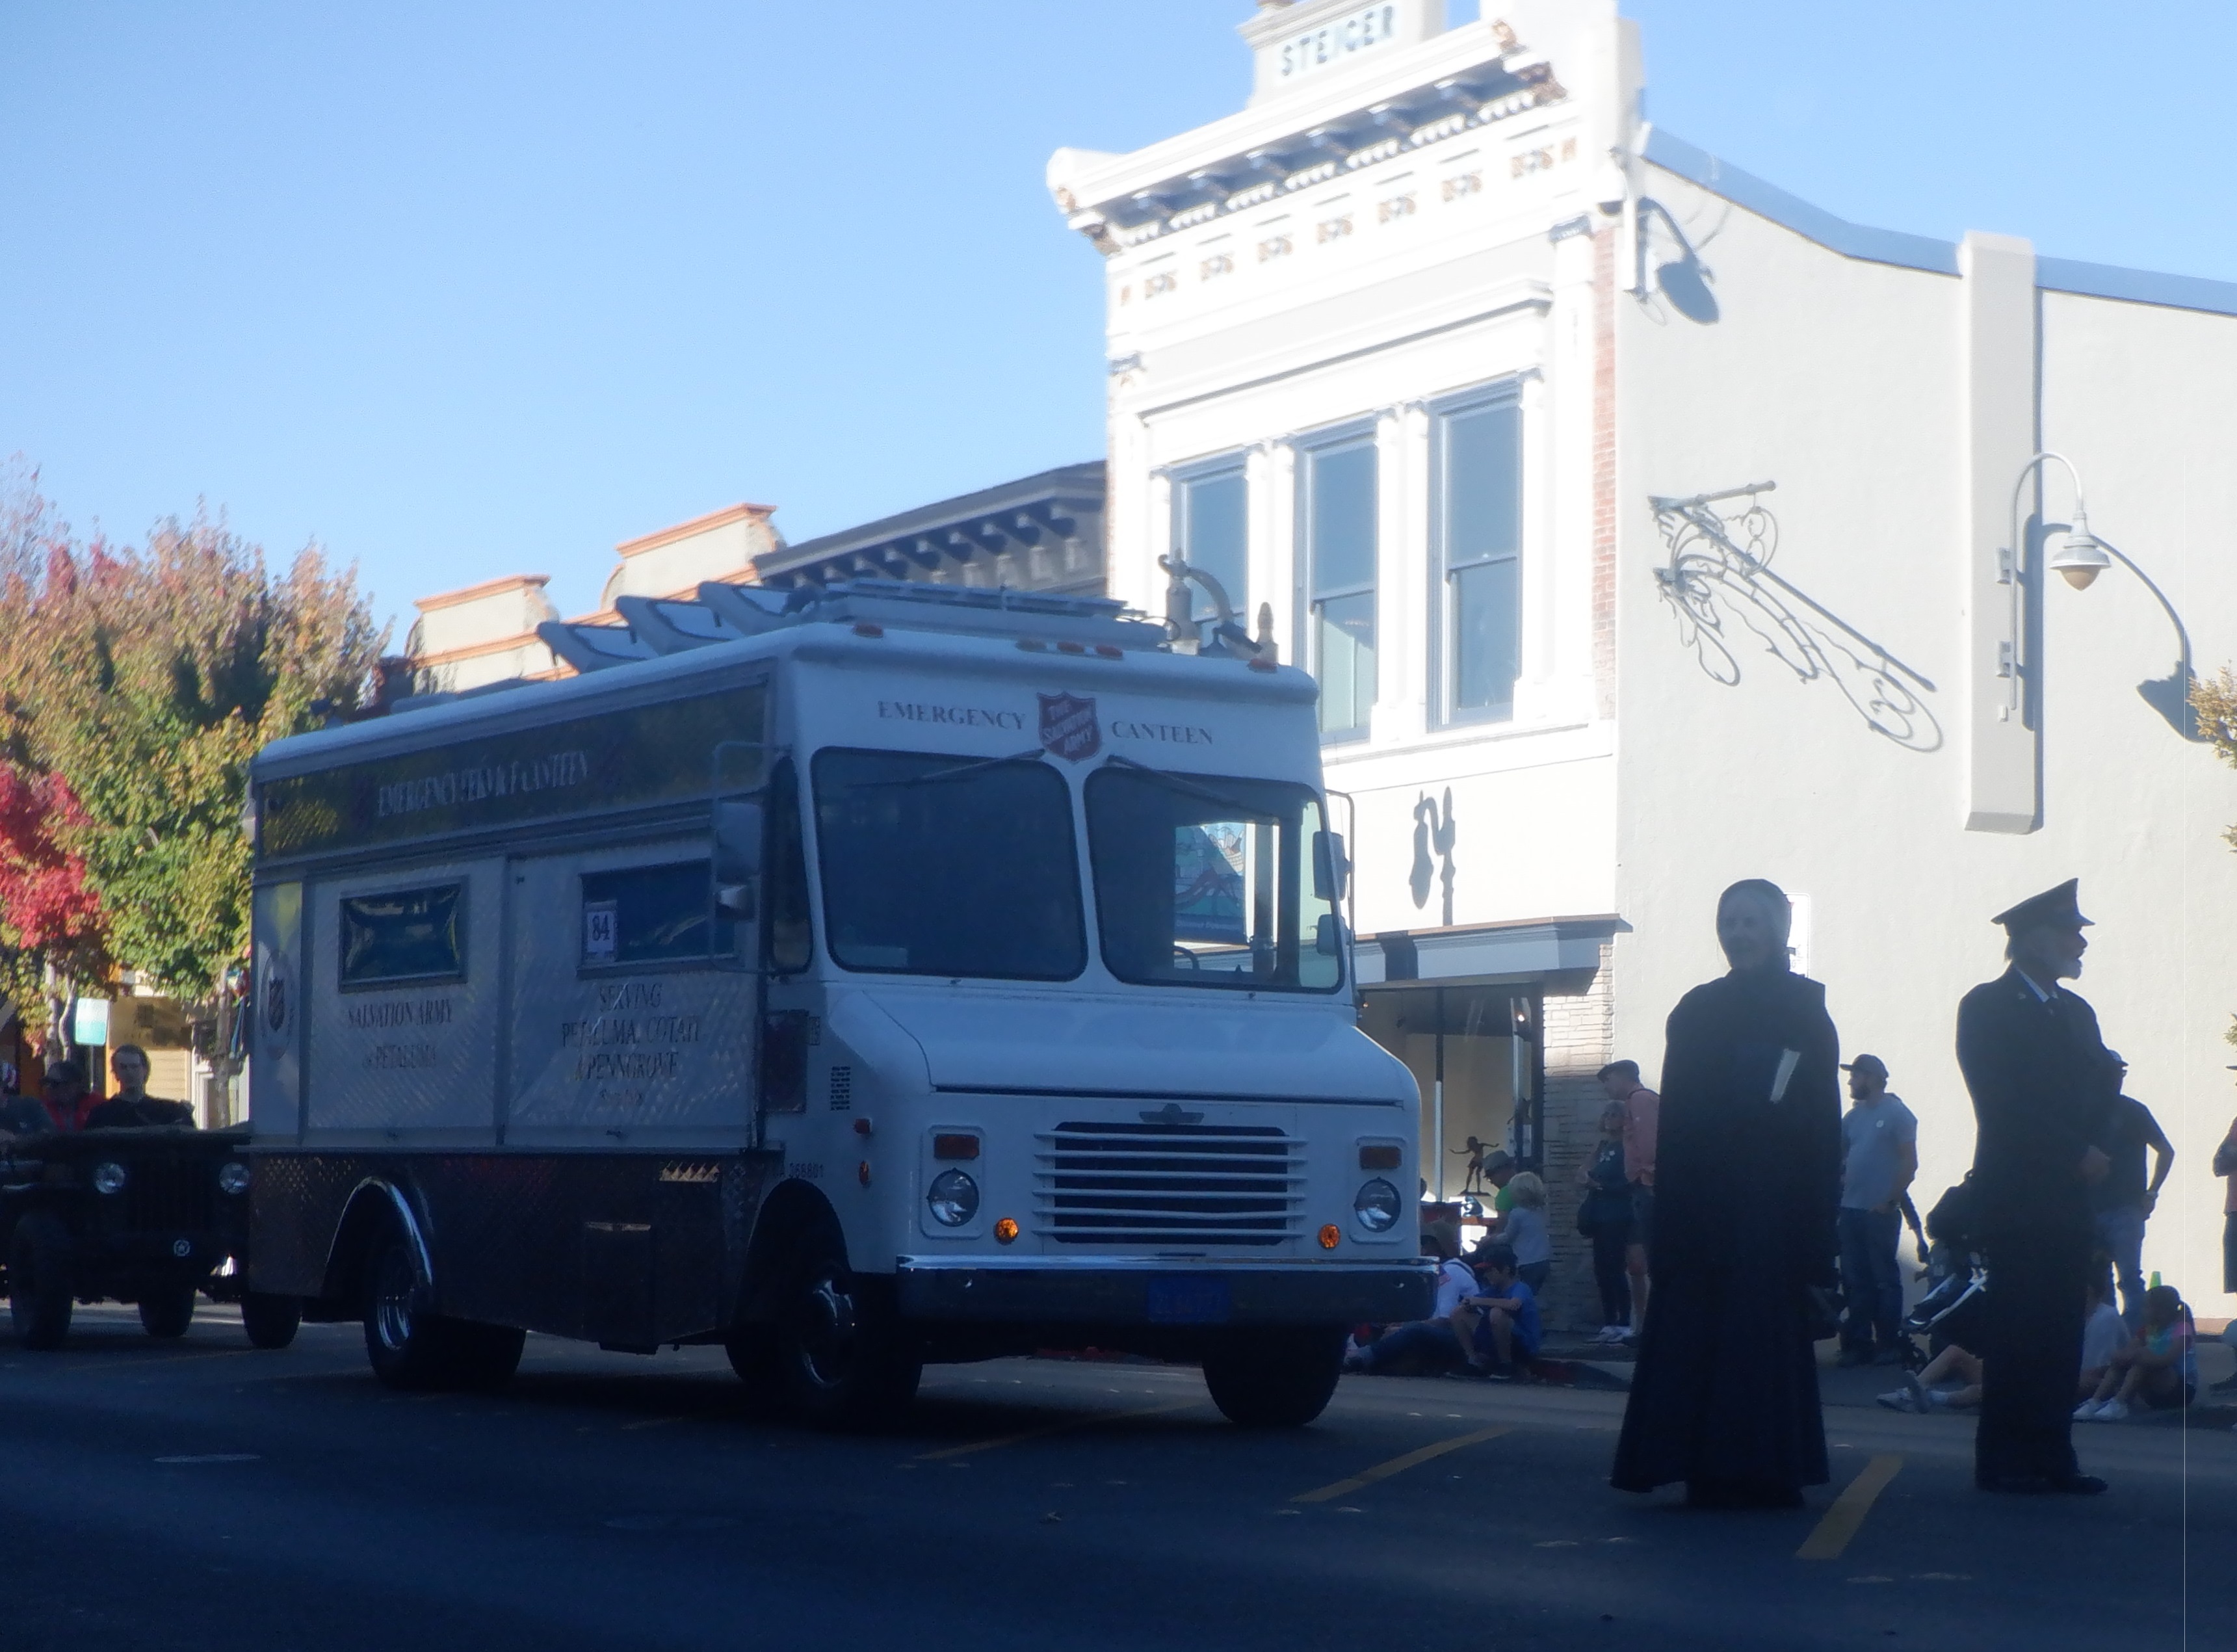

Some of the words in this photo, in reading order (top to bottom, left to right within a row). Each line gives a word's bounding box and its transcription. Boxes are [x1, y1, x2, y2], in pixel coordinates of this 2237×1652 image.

[878, 701, 1025, 729] EMERGENCY
[1112, 721, 1212, 744] CANTEEN
[592, 915, 610, 941] 84
[600, 982, 663, 1011] SERVING
[348, 1002, 413, 1029] SALVATION
